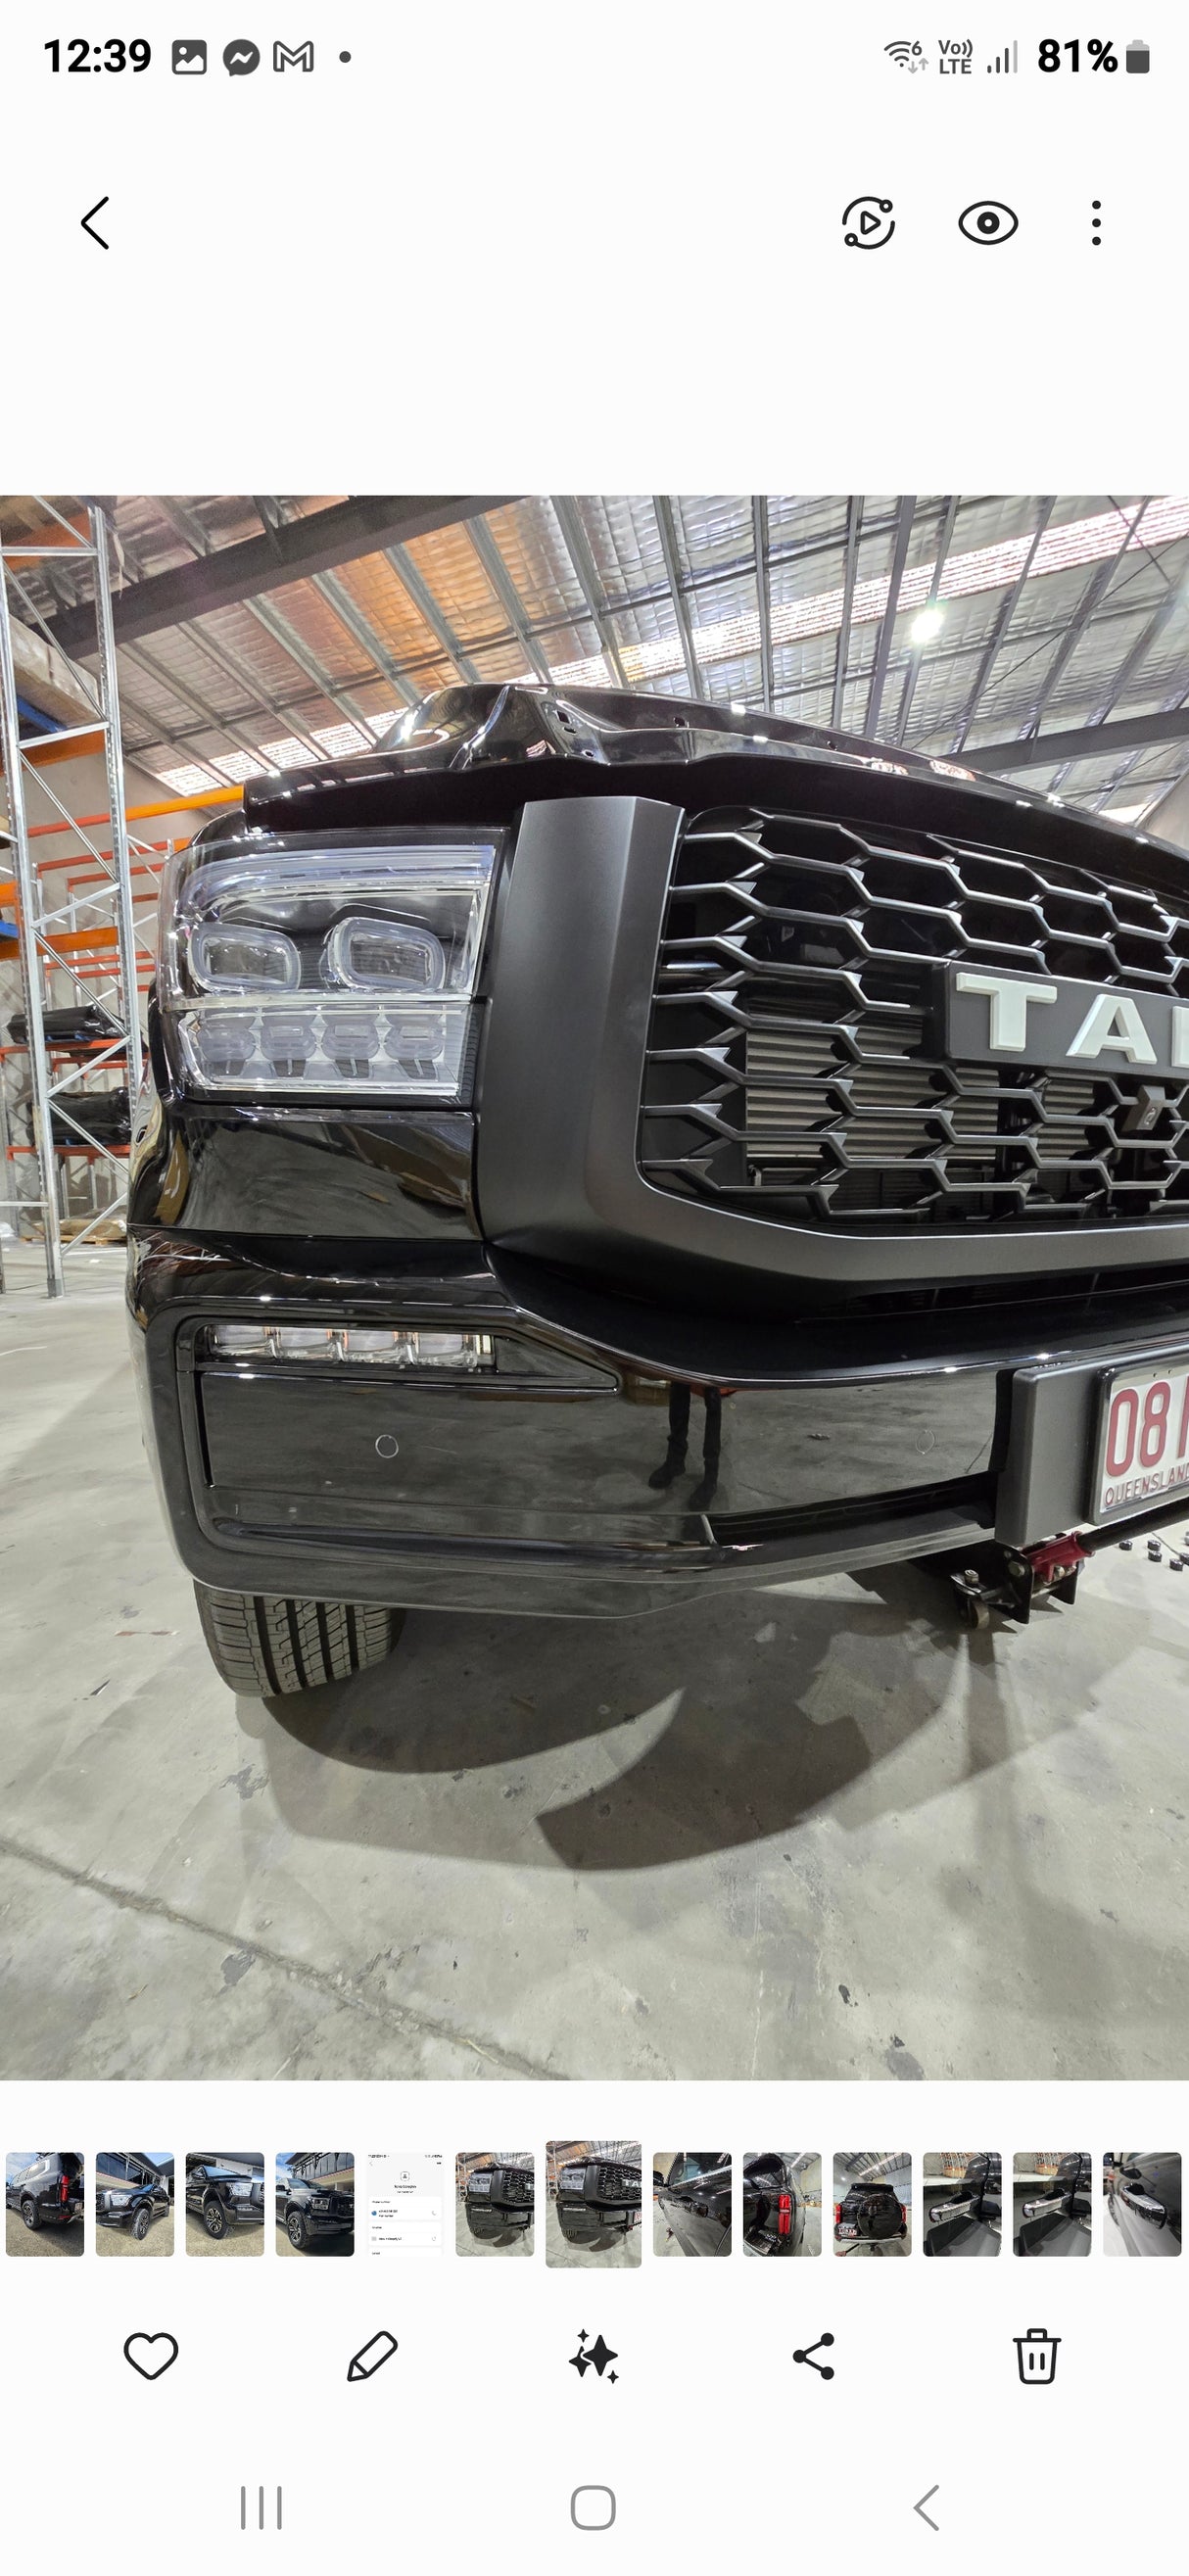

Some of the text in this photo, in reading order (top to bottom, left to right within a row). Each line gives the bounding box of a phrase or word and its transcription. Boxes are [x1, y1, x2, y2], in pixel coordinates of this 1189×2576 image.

[44, 39, 152, 73] 12:39
[939, 59, 973, 74] LTE
[1037, 38, 1118, 73] 81%
